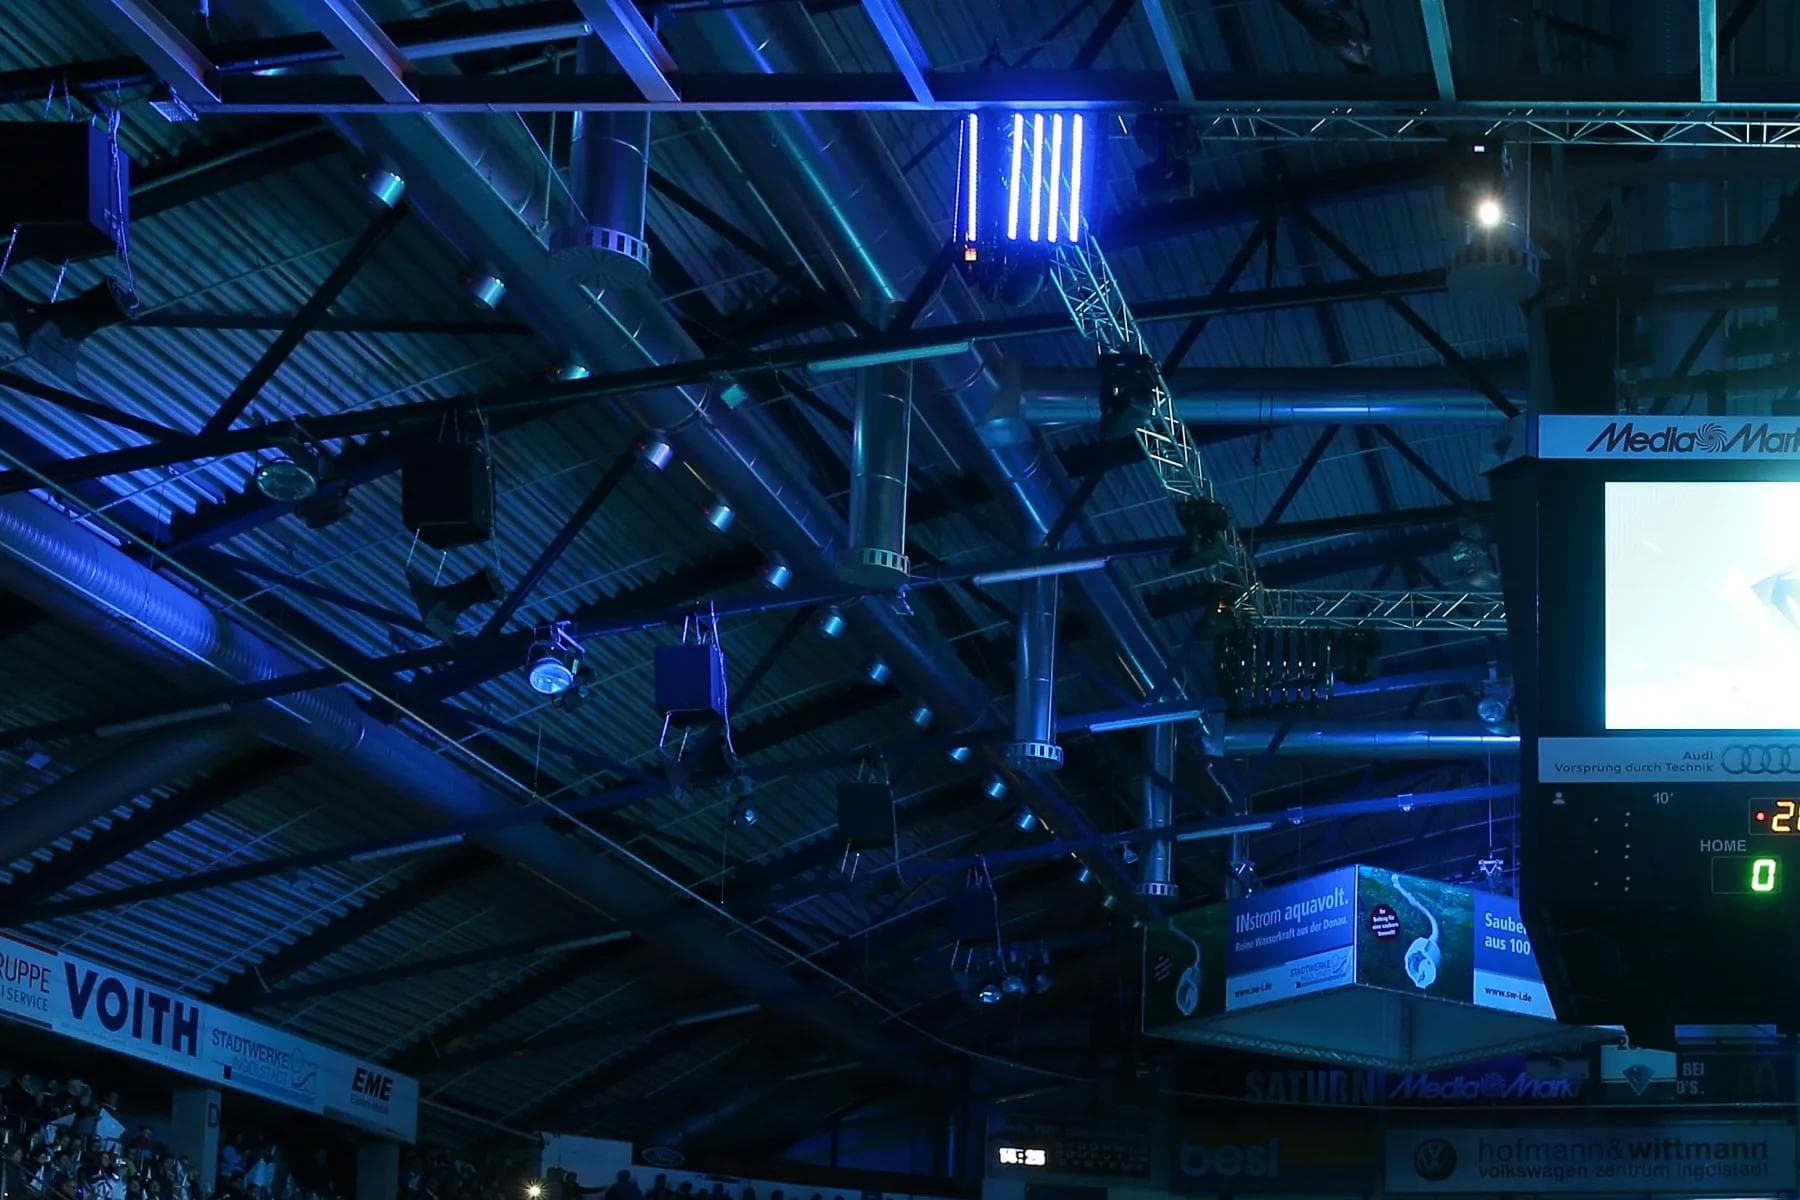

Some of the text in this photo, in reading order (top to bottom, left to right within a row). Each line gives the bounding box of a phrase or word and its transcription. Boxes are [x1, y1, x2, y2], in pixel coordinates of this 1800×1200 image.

[1586, 422, 1696, 453] Media
[1554, 762, 1713, 774] Vorsprung durch Technik
[1683, 751, 1713, 761] Audi
[1700, 839, 1747, 852] HOME
[1751, 858, 1776, 892] 0
[1236, 909, 1281, 934] INstrom
[1284, 887, 1349, 923] aquavolt.
[1485, 935, 1531, 955] aus 100
[8, 987, 48, 1012] SERVICE
[1485, 987, 1532, 1002] www.sw-i.de
[64, 960, 199, 1058] VOITH
[212, 1028, 289, 1069] STADTWERKE
[1245, 1071, 1376, 1104] SATURN
[1390, 1072, 1483, 1100] Media
[1478, 1161, 1769, 1181] volkswagen zentrum ingolstadt
